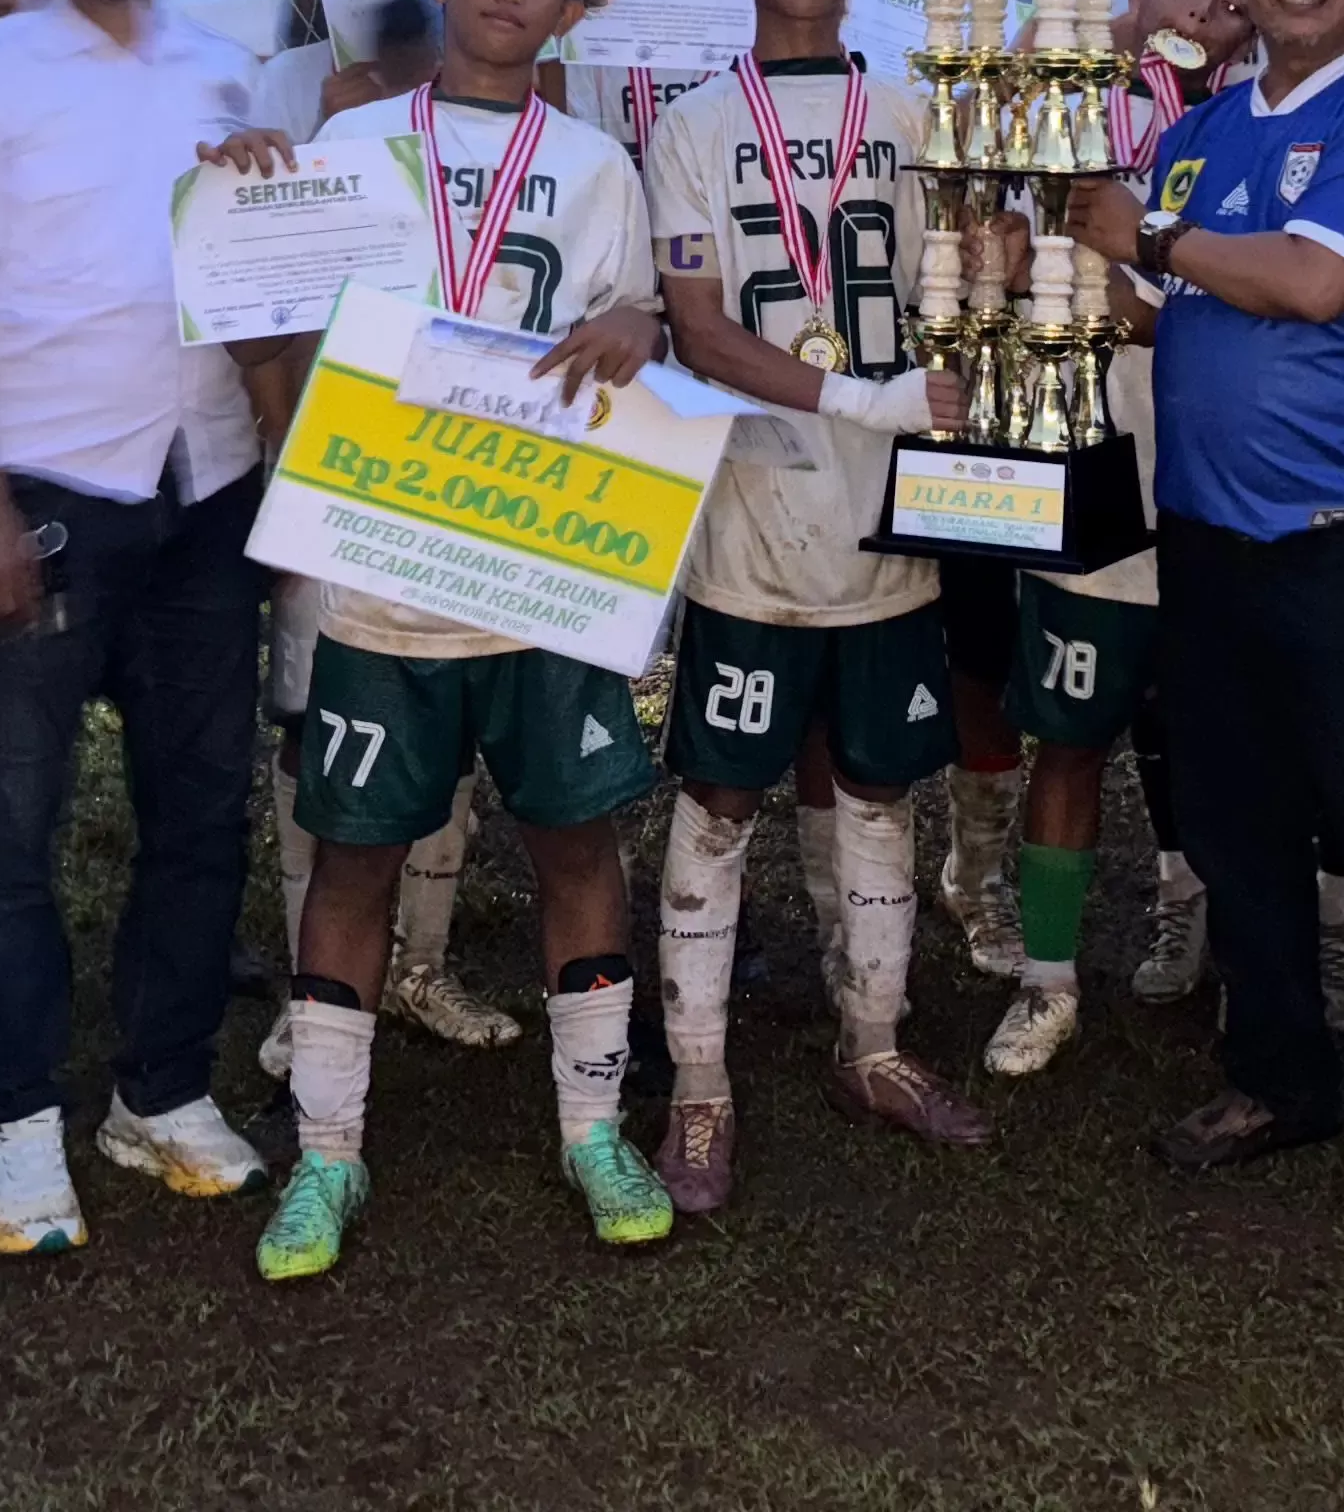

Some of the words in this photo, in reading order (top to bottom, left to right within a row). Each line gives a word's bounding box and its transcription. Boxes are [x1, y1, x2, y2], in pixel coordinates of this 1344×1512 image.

[233, 173, 362, 206] SERTIFIKAT
[669, 233, 704, 270] C
[404, 407, 573, 492] JUARA
[585, 468, 615, 504] 1
[909, 482, 1017, 513] JUARA
[1029, 497, 1044, 515] 1
[321, 504, 417, 549] TROFEO
[417, 532, 523, 584] KARANG
[523, 567, 619, 616] TARUNA
[330, 537, 488, 602] KECAMATAN
[487, 584, 592, 636] KEMANG
[704, 662, 775, 735] 28
[1040, 628, 1098, 701] 78
[319, 707, 387, 788] 77
